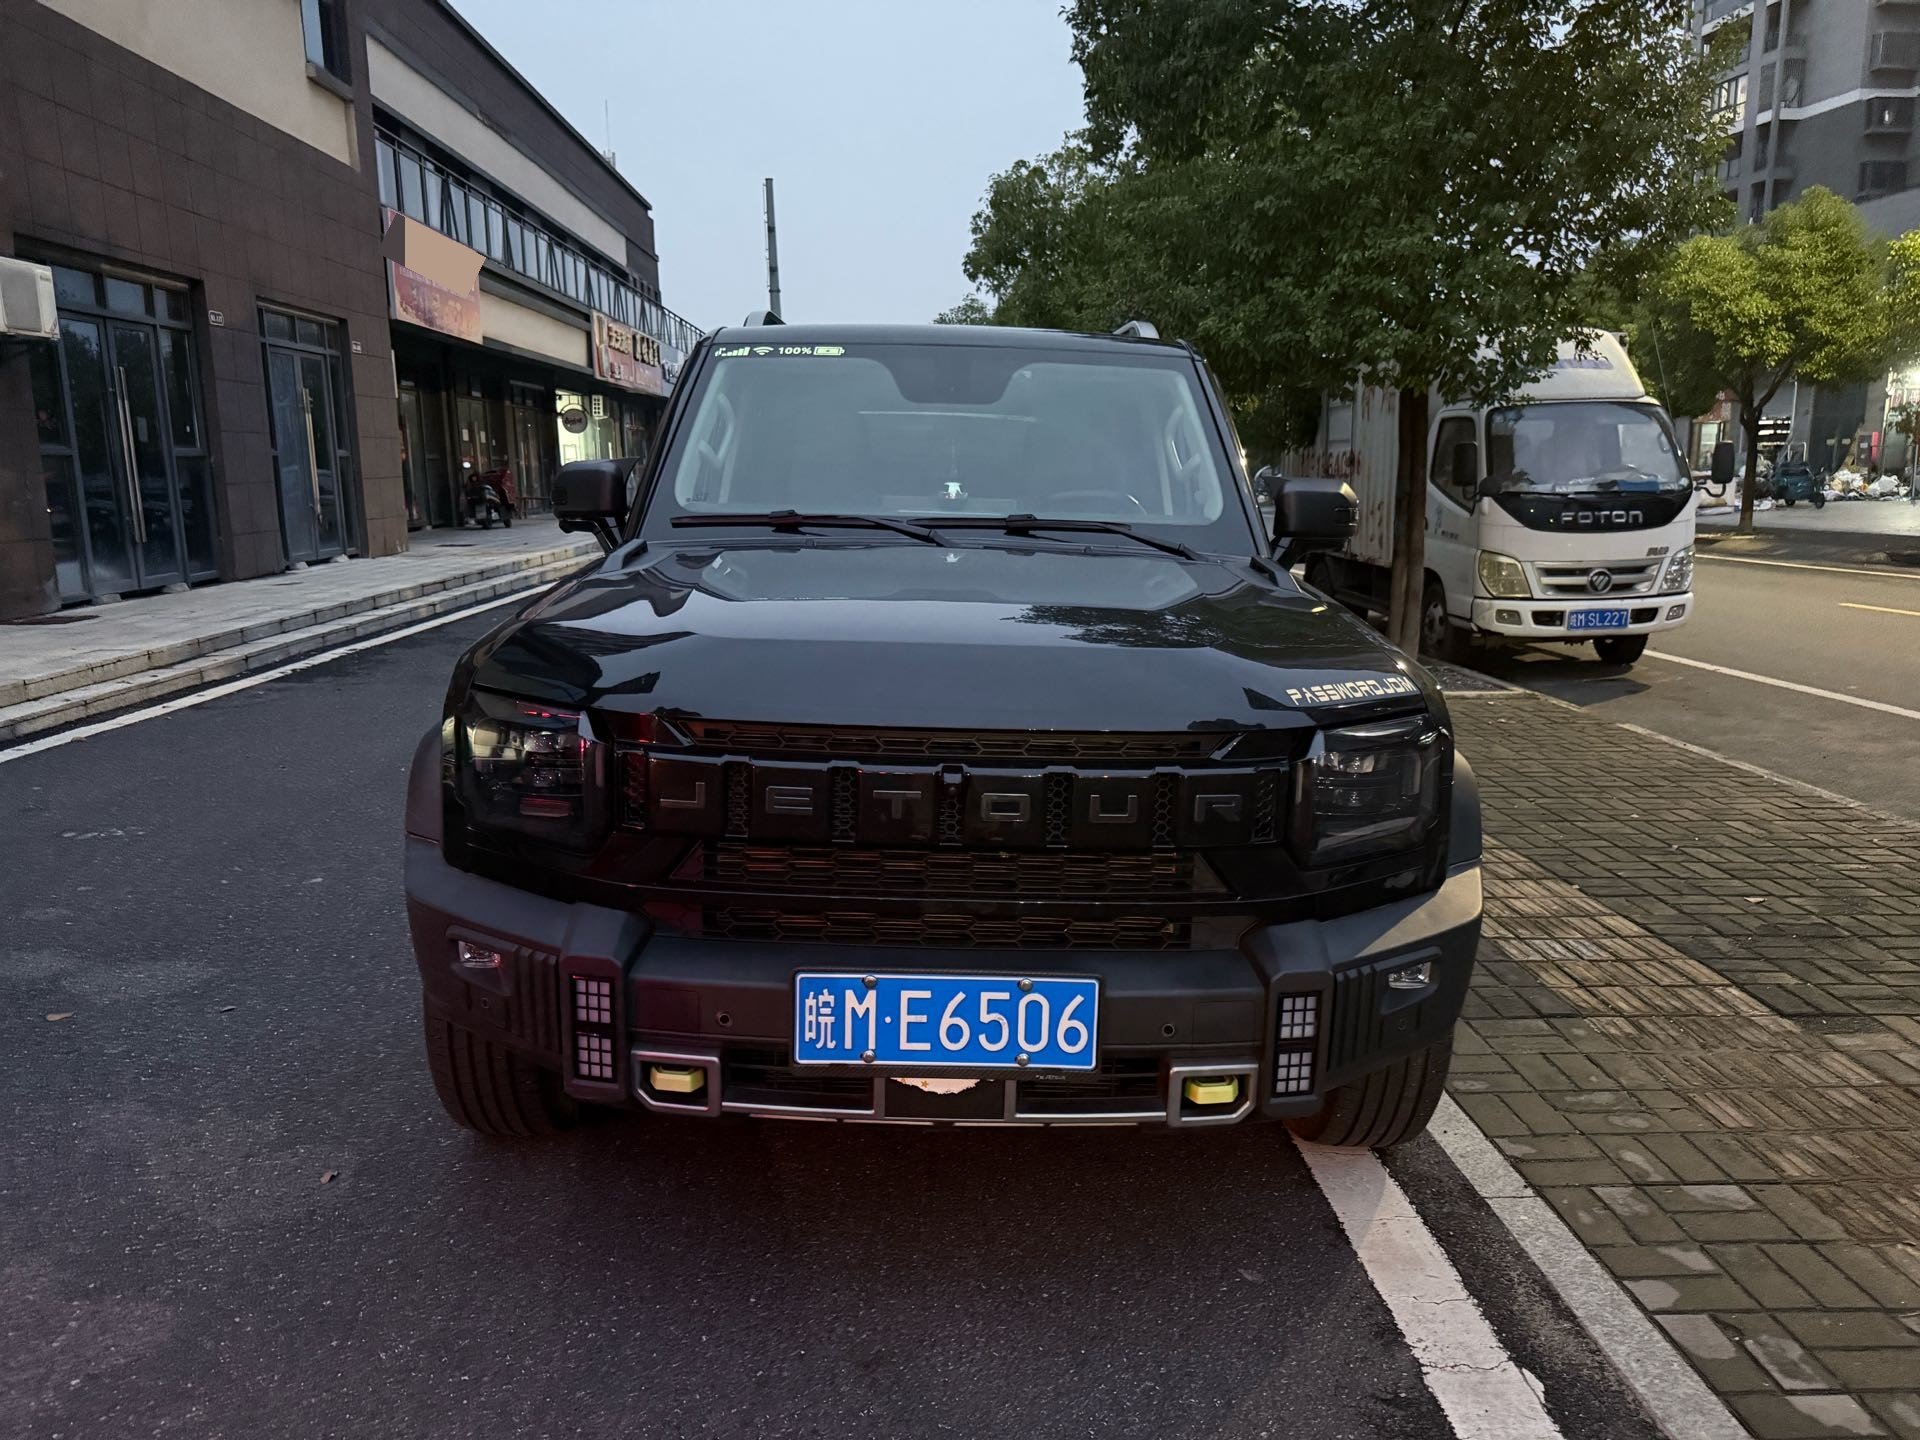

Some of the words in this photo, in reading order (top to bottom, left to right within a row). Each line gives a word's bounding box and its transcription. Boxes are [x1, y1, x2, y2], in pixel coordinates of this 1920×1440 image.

[778, 346, 812, 355] 100%
[1561, 510, 1643, 524] FOTON
[659, 780, 1243, 825] JETOUR
